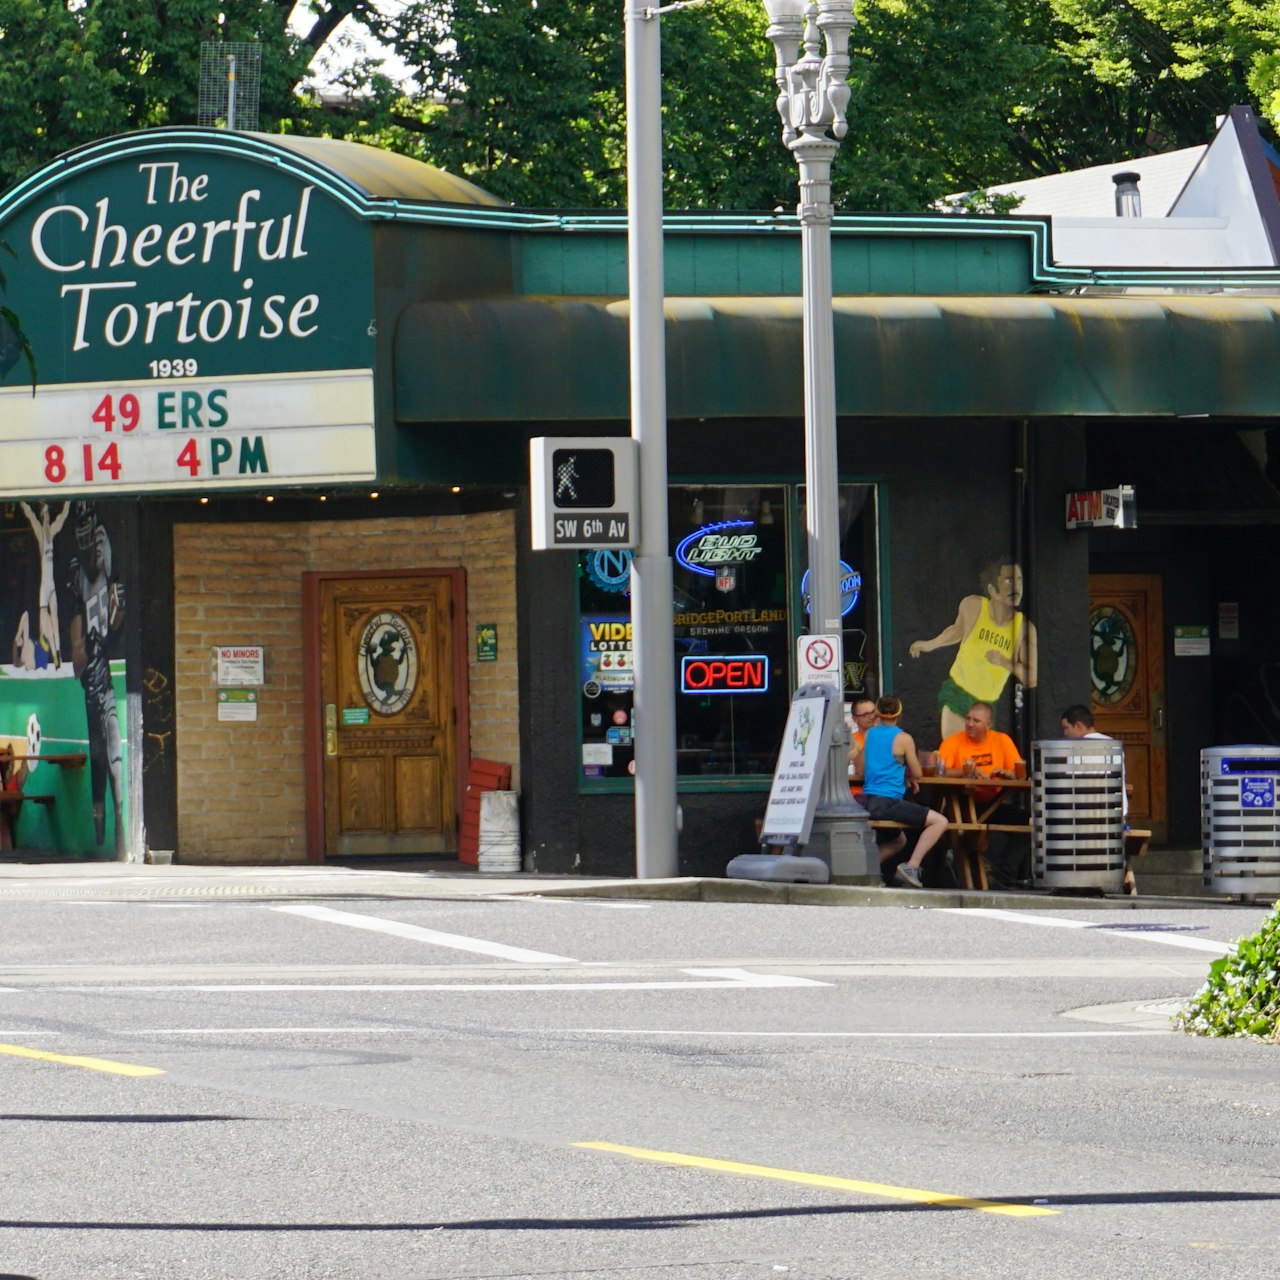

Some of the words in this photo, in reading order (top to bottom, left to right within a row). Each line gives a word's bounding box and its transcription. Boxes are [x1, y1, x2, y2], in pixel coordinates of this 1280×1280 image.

[138, 161, 209, 205] The
[31, 186, 316, 272] Cheerful
[61, 278, 320, 352] Tortoise
[149, 359, 198, 378] 1939
[92, 393, 141, 432] 49
[157, 389, 229, 430] ERS
[44, 445, 67, 483] 8
[82, 442, 122, 482] 14
[1067, 490, 1102, 522] ATM
[556, 519, 577, 538] SW
[583, 519, 603, 538] 6th
[608, 519, 626, 538] Av
[698, 535, 758, 549] BUD
[687, 547, 762, 562] LIGHT
[718, 576, 733, 588] NFL
[840, 574, 862, 593] OON
[690, 627, 730, 636] BREWING
[734, 625, 769, 634] OREGON
[978, 628, 1012, 651] OREGON
[221, 649, 232, 658] NO
[233, 649, 259, 658] MINORS
[685, 661, 762, 688] OPEN
